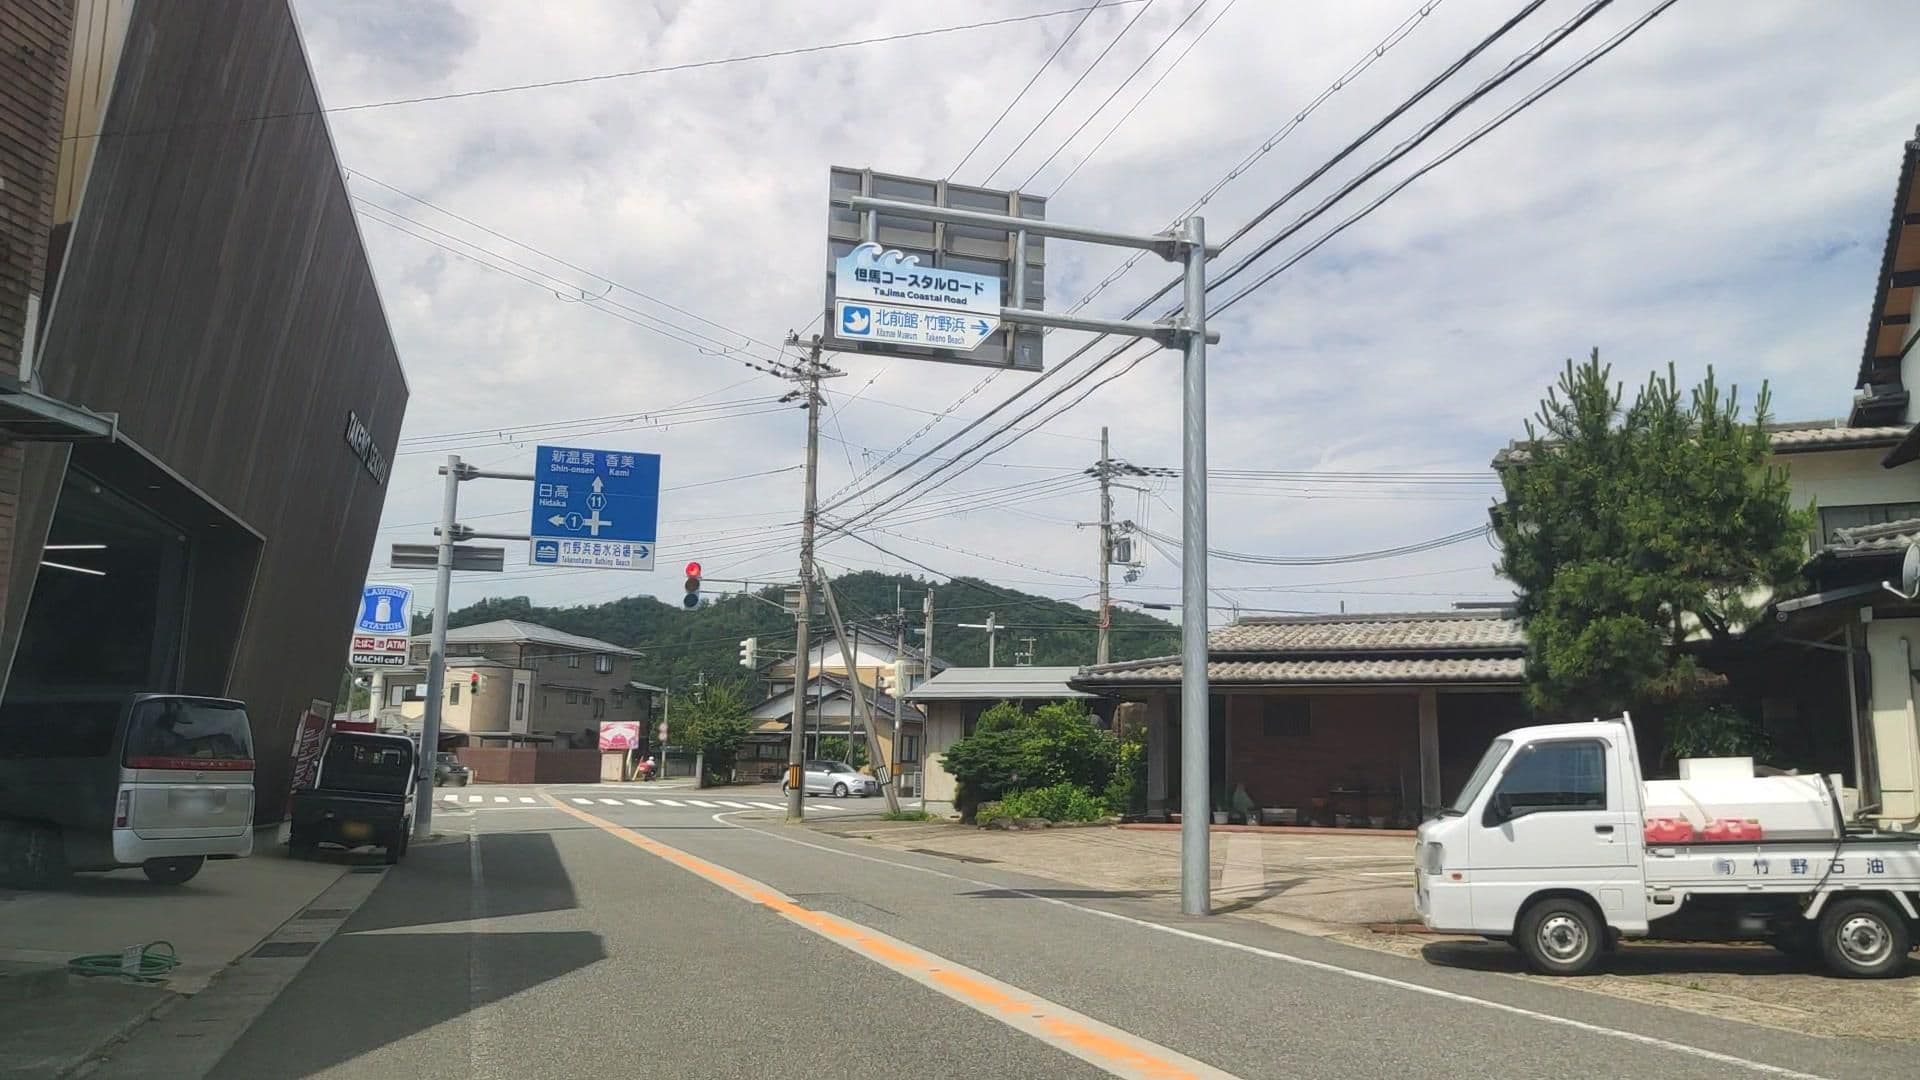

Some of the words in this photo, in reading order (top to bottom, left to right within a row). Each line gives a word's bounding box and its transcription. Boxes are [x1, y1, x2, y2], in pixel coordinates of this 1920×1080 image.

[855, 267, 984, 295] 但馬コースタルロード
[907, 291, 943, 303] Coastal
[943, 294, 968, 305] Road
[925, 333, 946, 343] Takeno
[947, 335, 965, 345] Beach
[551, 450, 595, 466] 新温泉
[605, 454, 635, 469] 香美
[551, 463, 594, 474] Shin-onsen
[609, 468, 630, 477] Kami
[539, 484, 569, 499] 日高
[590, 496, 602, 506] 11
[365, 588, 406, 599] LAWSON
[361, 620, 402, 630] STATION
[387, 641, 406, 649] ATM
